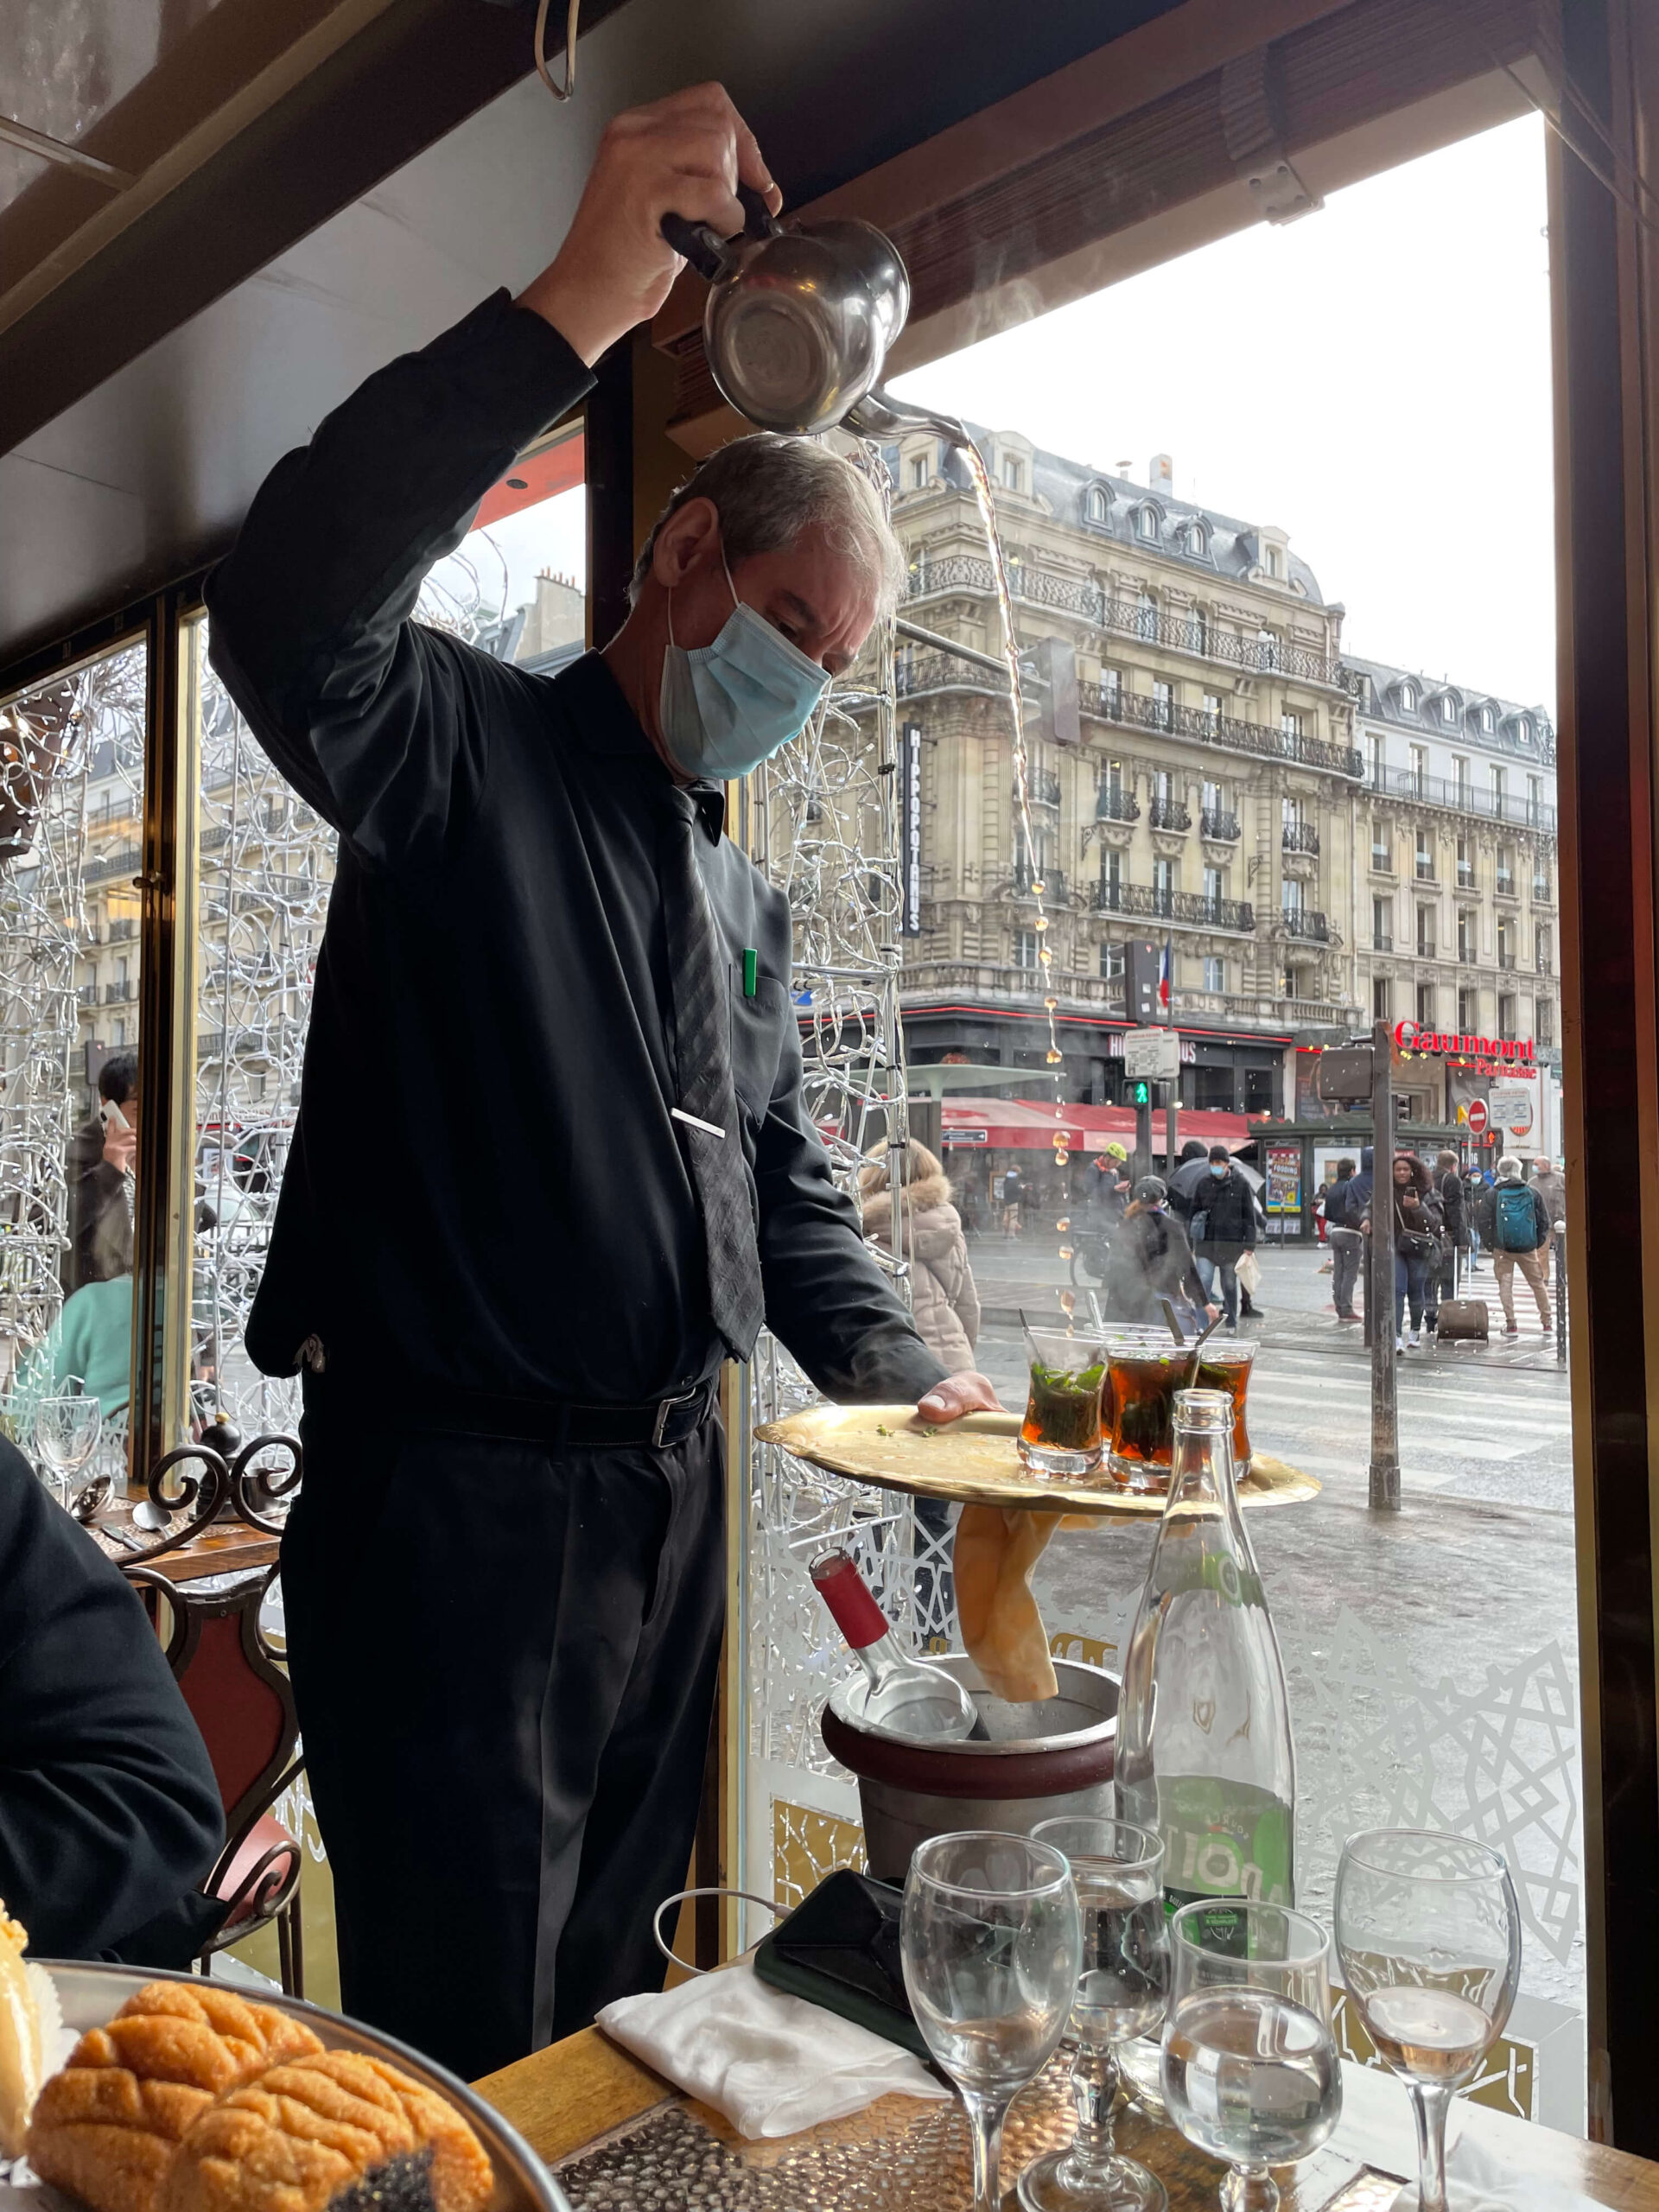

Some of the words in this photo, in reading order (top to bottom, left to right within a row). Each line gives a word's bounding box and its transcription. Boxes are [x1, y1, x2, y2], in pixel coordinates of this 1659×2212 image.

[909, 728, 921, 931] HIPPOPOTAMUS
[1395, 1020, 1537, 1060] Gaumont
[1476, 1059, 1537, 1079] Parnasse
